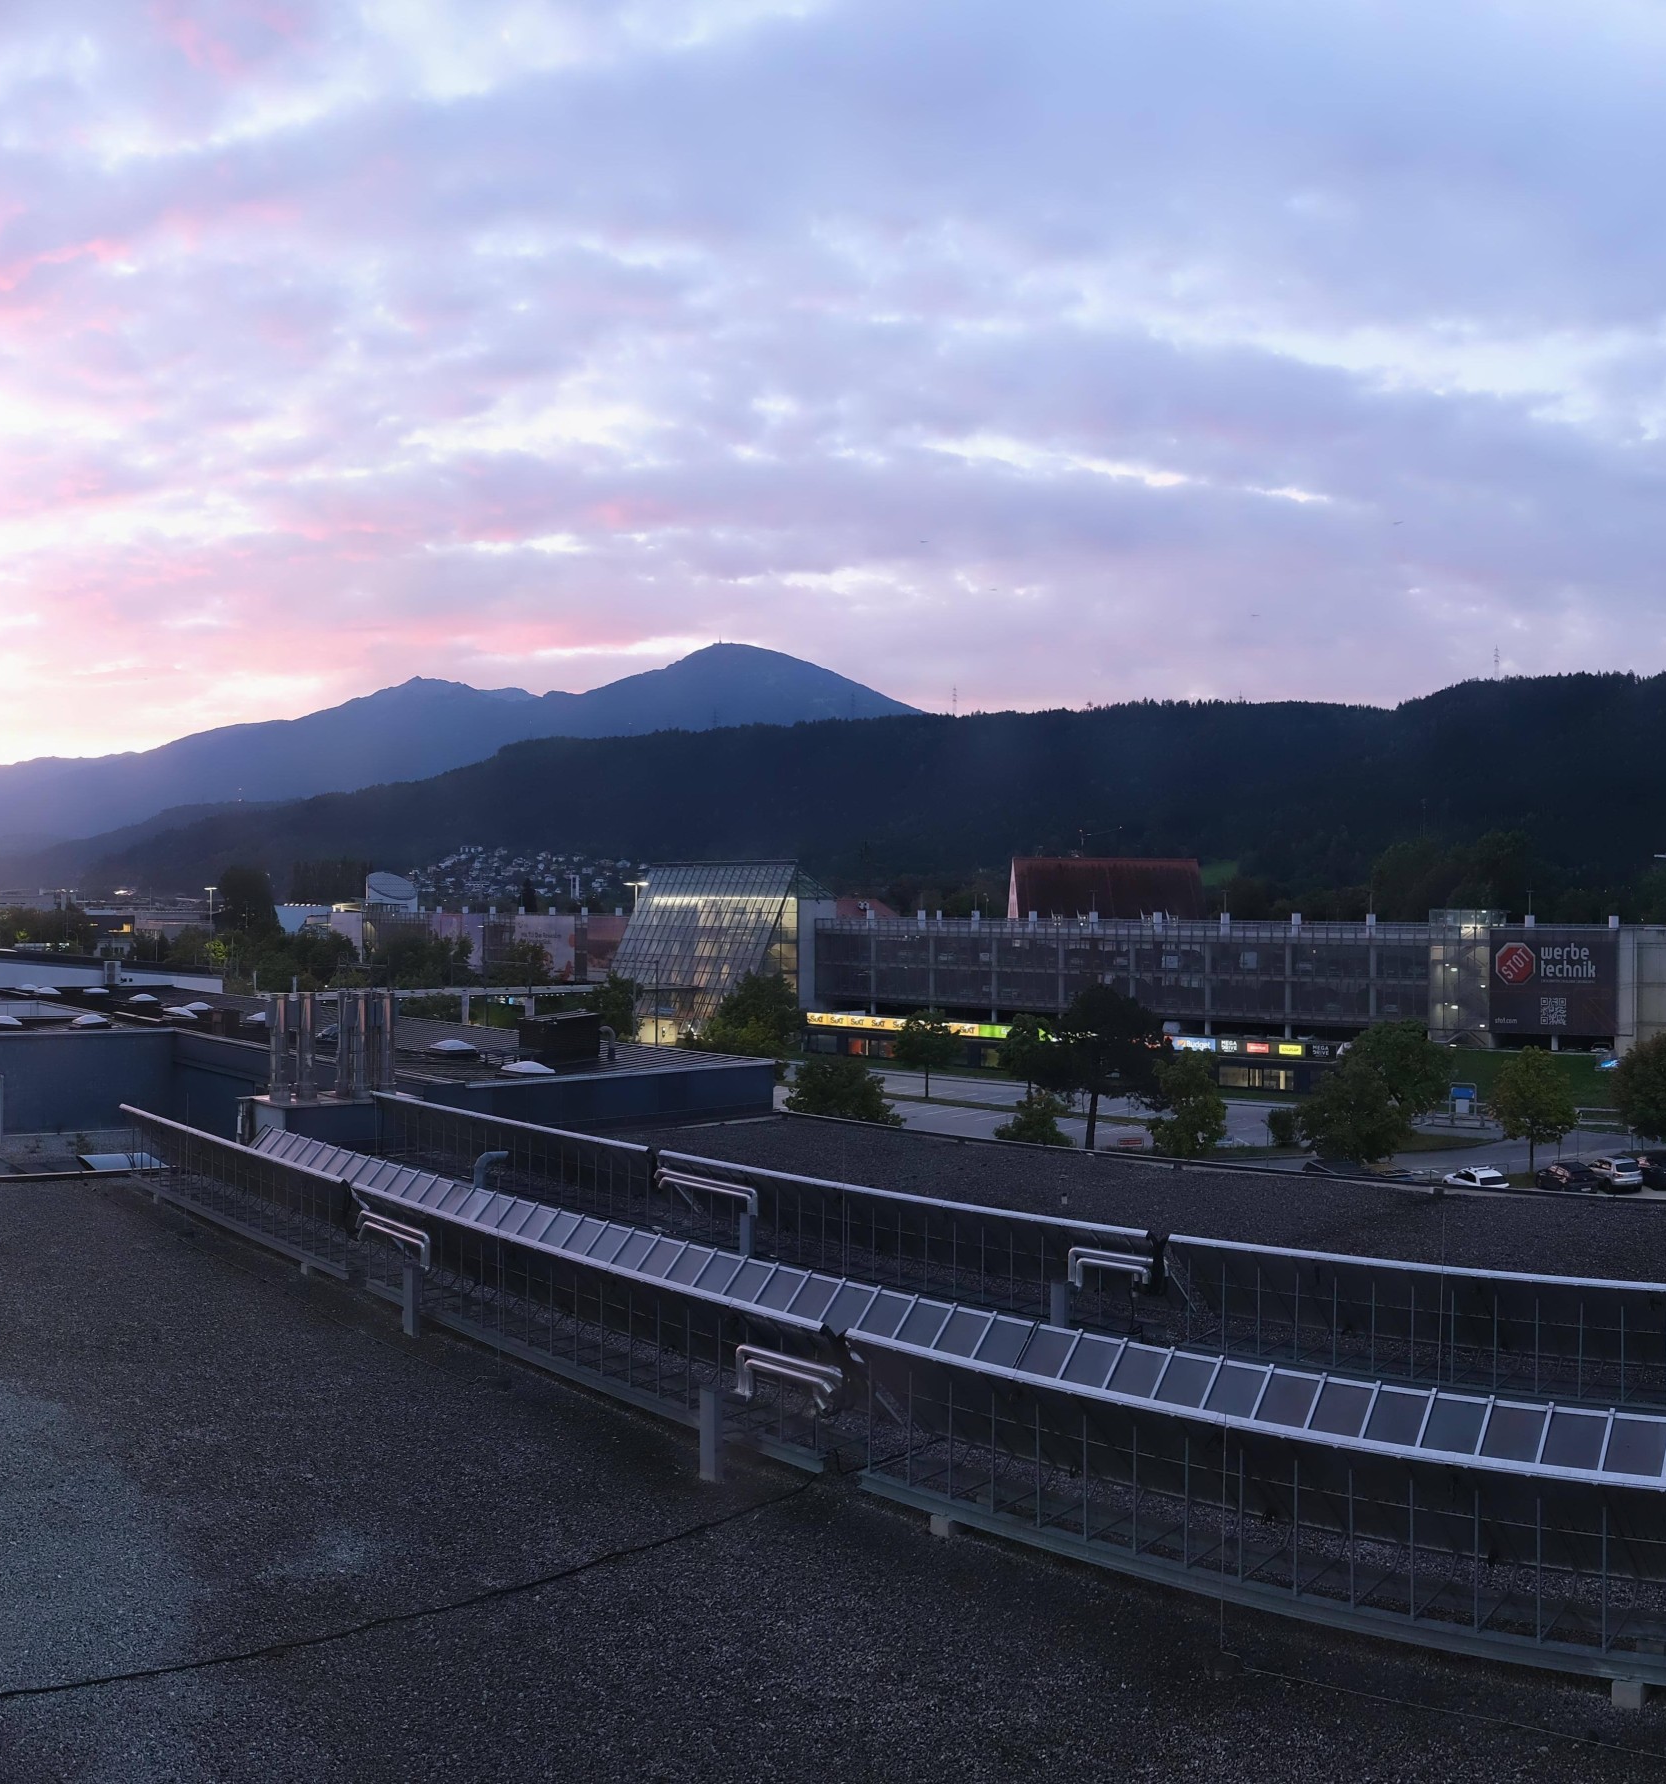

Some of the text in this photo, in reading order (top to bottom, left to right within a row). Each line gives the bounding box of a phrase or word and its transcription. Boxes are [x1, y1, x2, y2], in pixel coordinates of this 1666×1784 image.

[1540, 942, 1590, 960] werbe
[1540, 960, 1596, 978] technik
[1186, 1040, 1211, 1050] Budget
